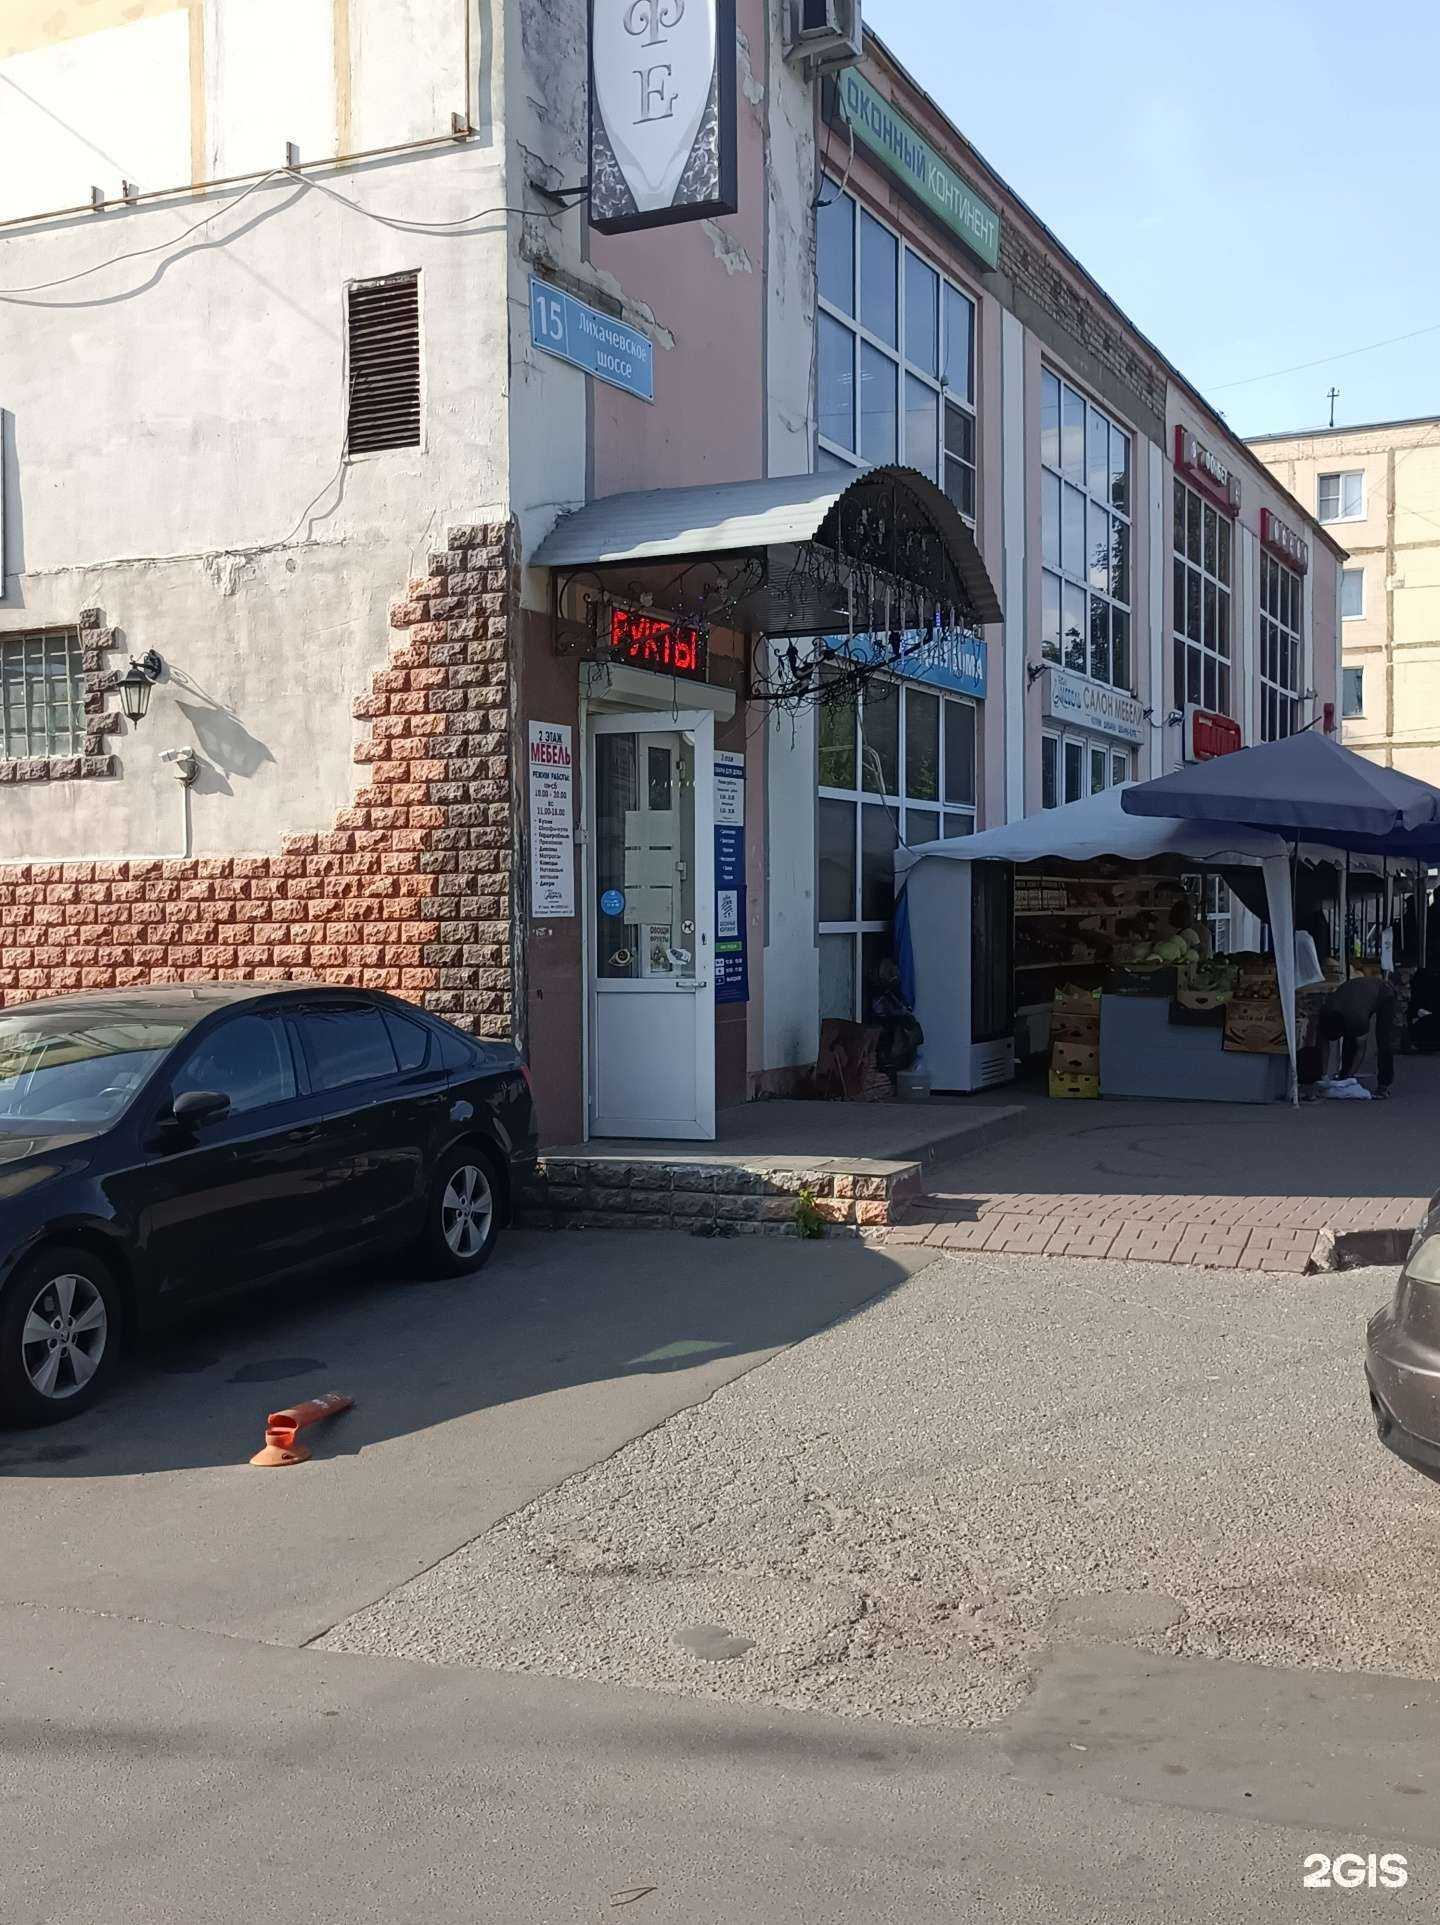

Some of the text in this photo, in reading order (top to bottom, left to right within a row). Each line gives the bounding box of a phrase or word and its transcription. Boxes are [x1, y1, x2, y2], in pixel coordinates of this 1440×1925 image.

[847, 77, 995, 249] ОКОННЫЙ КОНТИНЕНТ
[537, 296, 562, 340] 15
[579, 312, 647, 362] Лихачевское
[597, 350, 632, 378] шоссе
[1083, 687, 1113, 716] САЛОН
[1114, 698, 1144, 726] МЕБЕЛИ
[539, 730, 563, 743] 2 ЭТАЖ
[531, 742, 571, 766] МЕБЕЛЬ
[532, 771, 549, 779] РЕЖИМ
